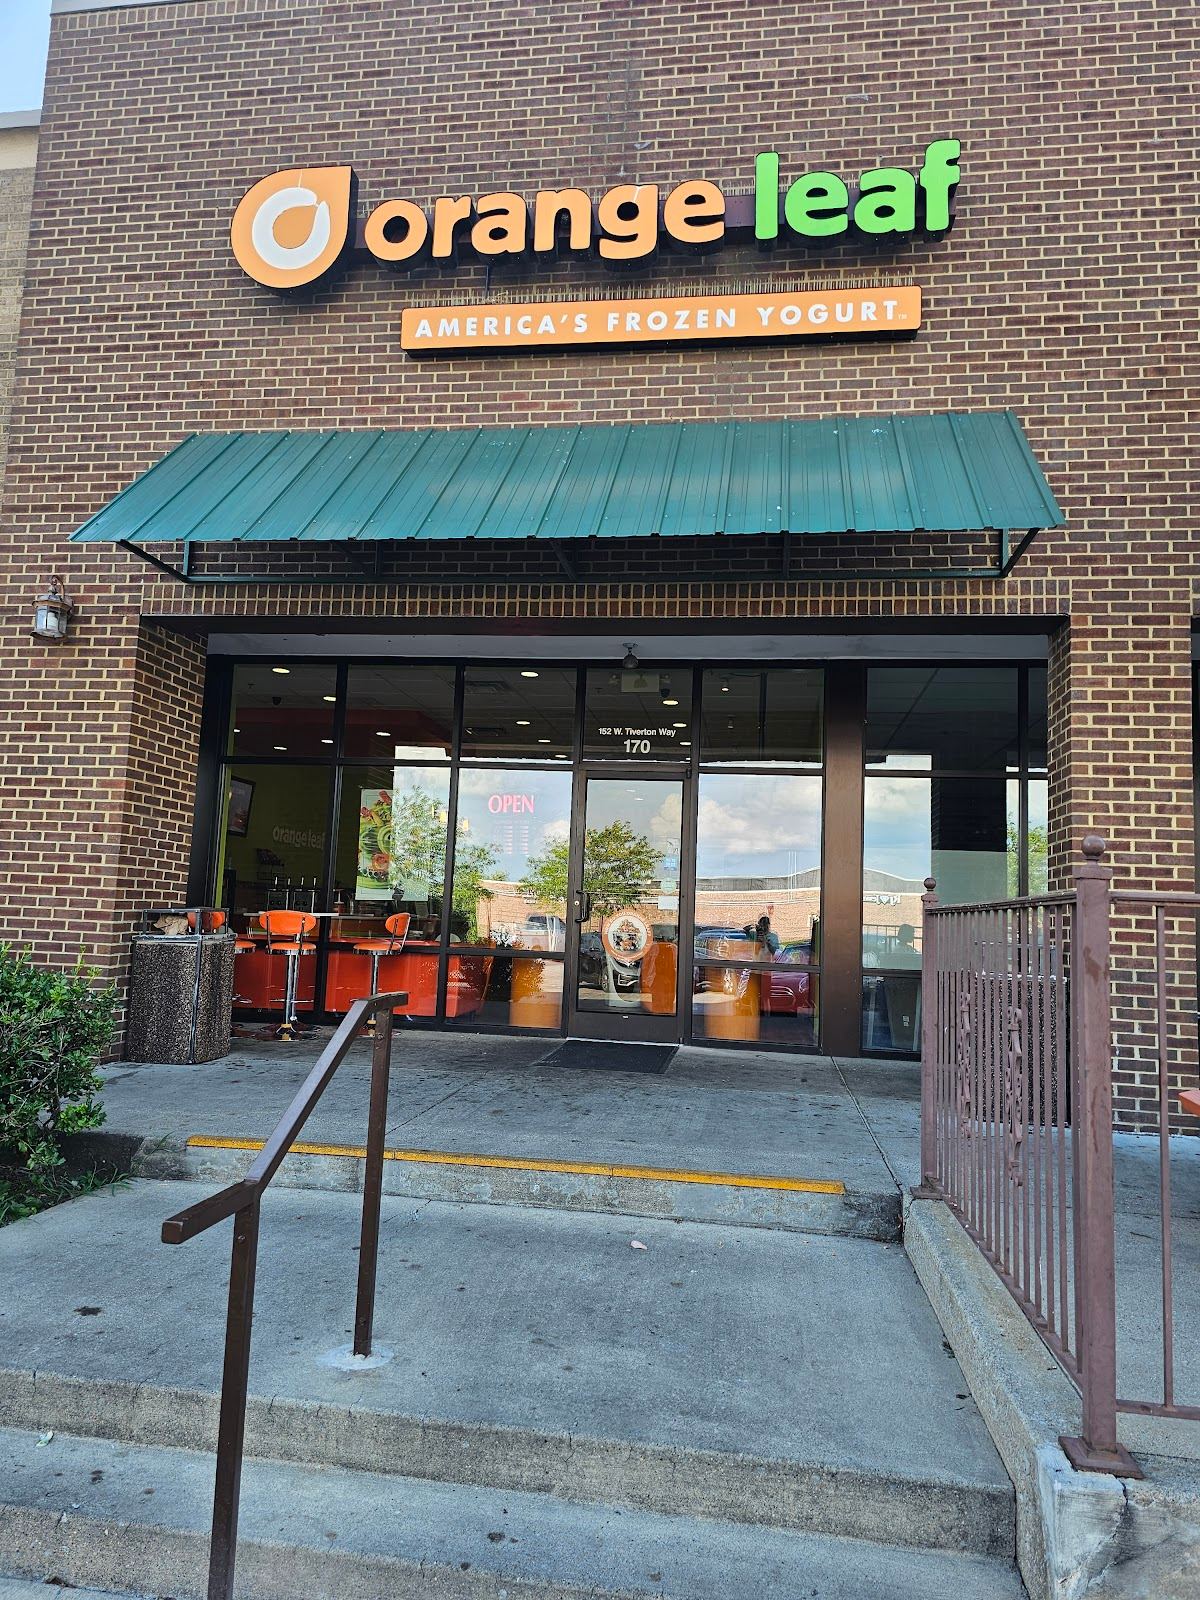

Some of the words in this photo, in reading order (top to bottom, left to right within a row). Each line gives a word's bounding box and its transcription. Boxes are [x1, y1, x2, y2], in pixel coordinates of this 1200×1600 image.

[364, 179, 726, 261] orange
[755, 138, 961, 240] leaf
[415, 313, 588, 338] AMERICA'S
[607, 308, 736, 332] FROZEN
[756, 300, 898, 326] YOGURT
[598, 727, 612, 735] 152
[613, 727, 623, 735] W.
[625, 727, 657, 736] Tiverton
[659, 727, 676, 738] Way
[623, 739, 651, 754] 170
[488, 794, 535, 813] OPEN
